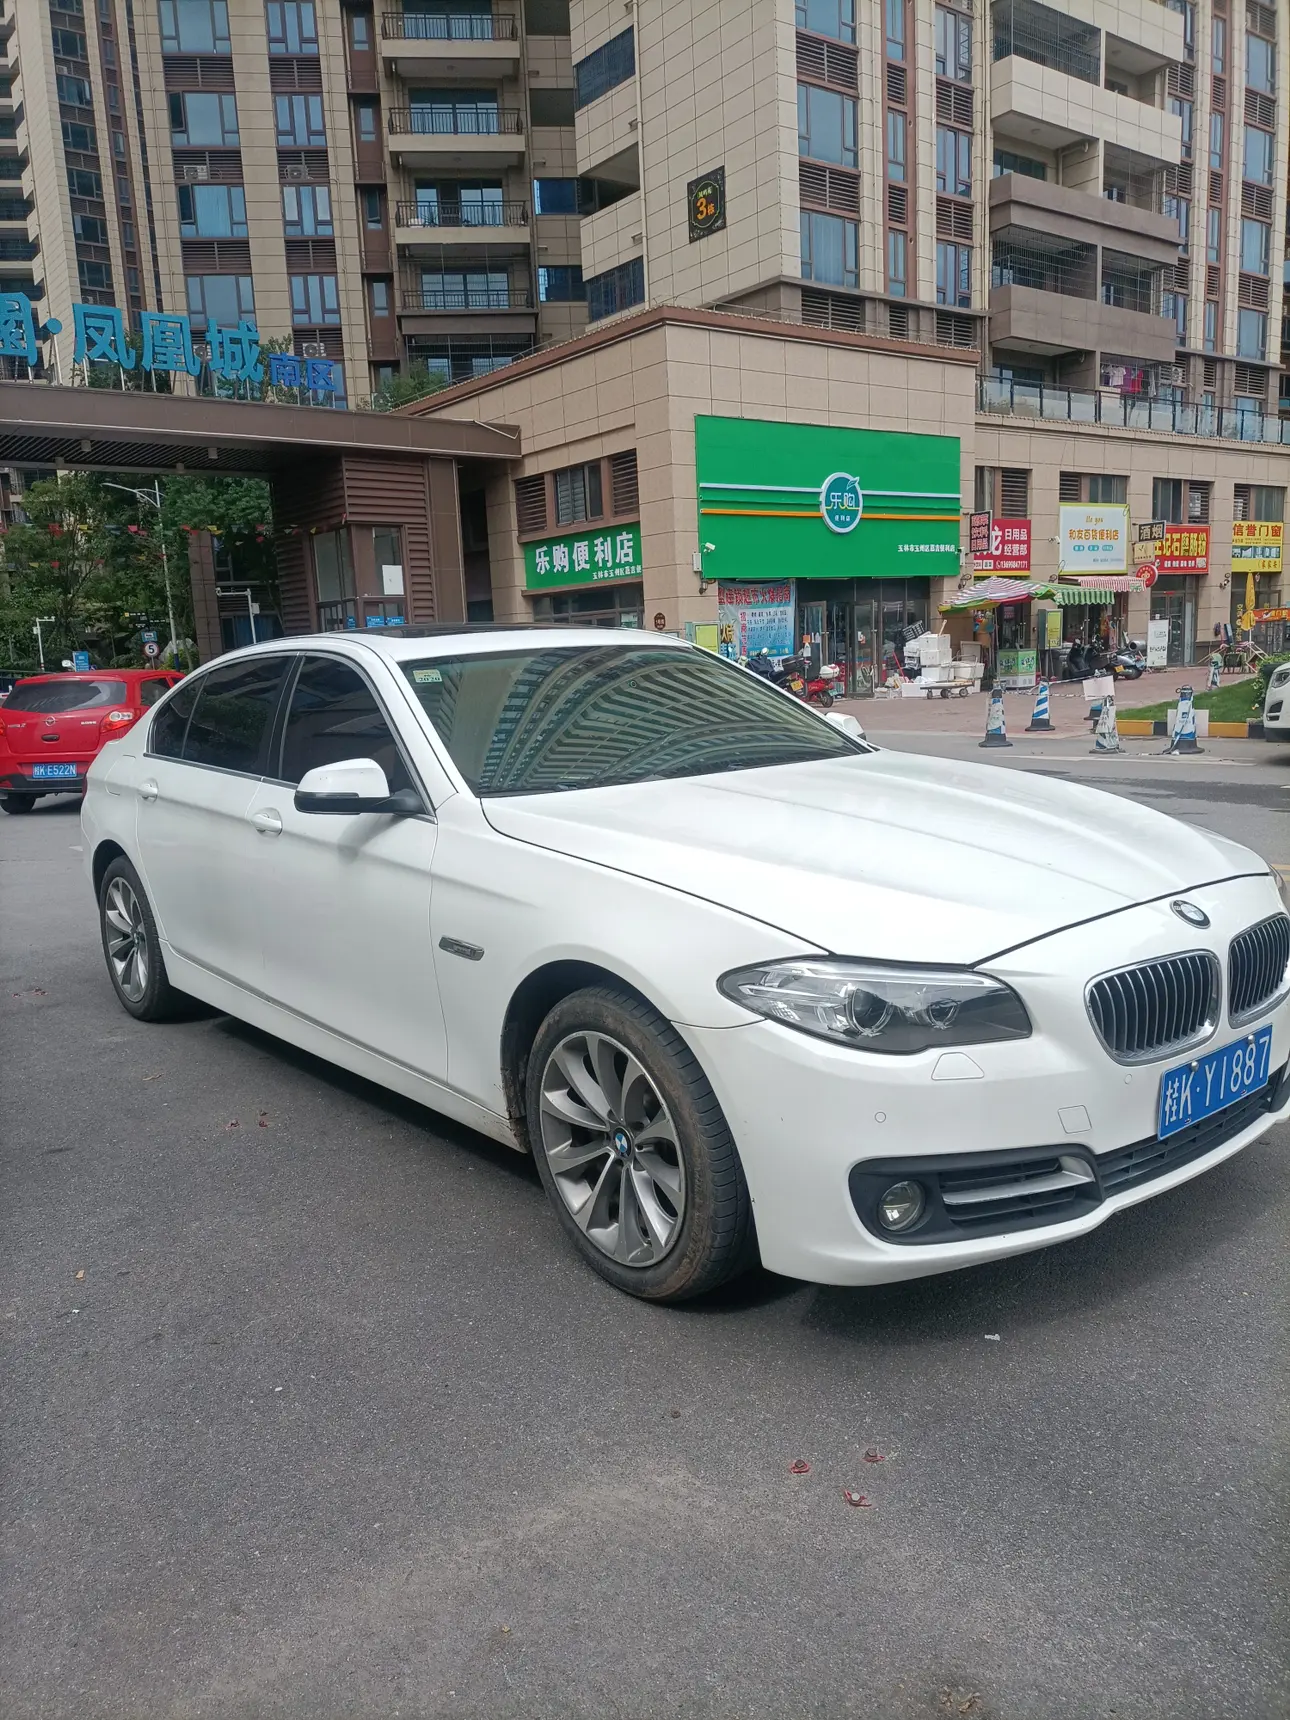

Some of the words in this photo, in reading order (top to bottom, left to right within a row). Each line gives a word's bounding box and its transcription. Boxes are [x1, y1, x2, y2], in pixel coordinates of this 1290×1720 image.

[269, 353, 337, 391] 南区
[830, 492, 856, 509] 乐购
[1004, 528, 1028, 541] 日用品
[1232, 523, 1282, 537] 信誉门窗
[535, 531, 634, 575] 乐购便利店
[1004, 543, 1028, 556] 经营部
[148, 644, 155, 654] 5
